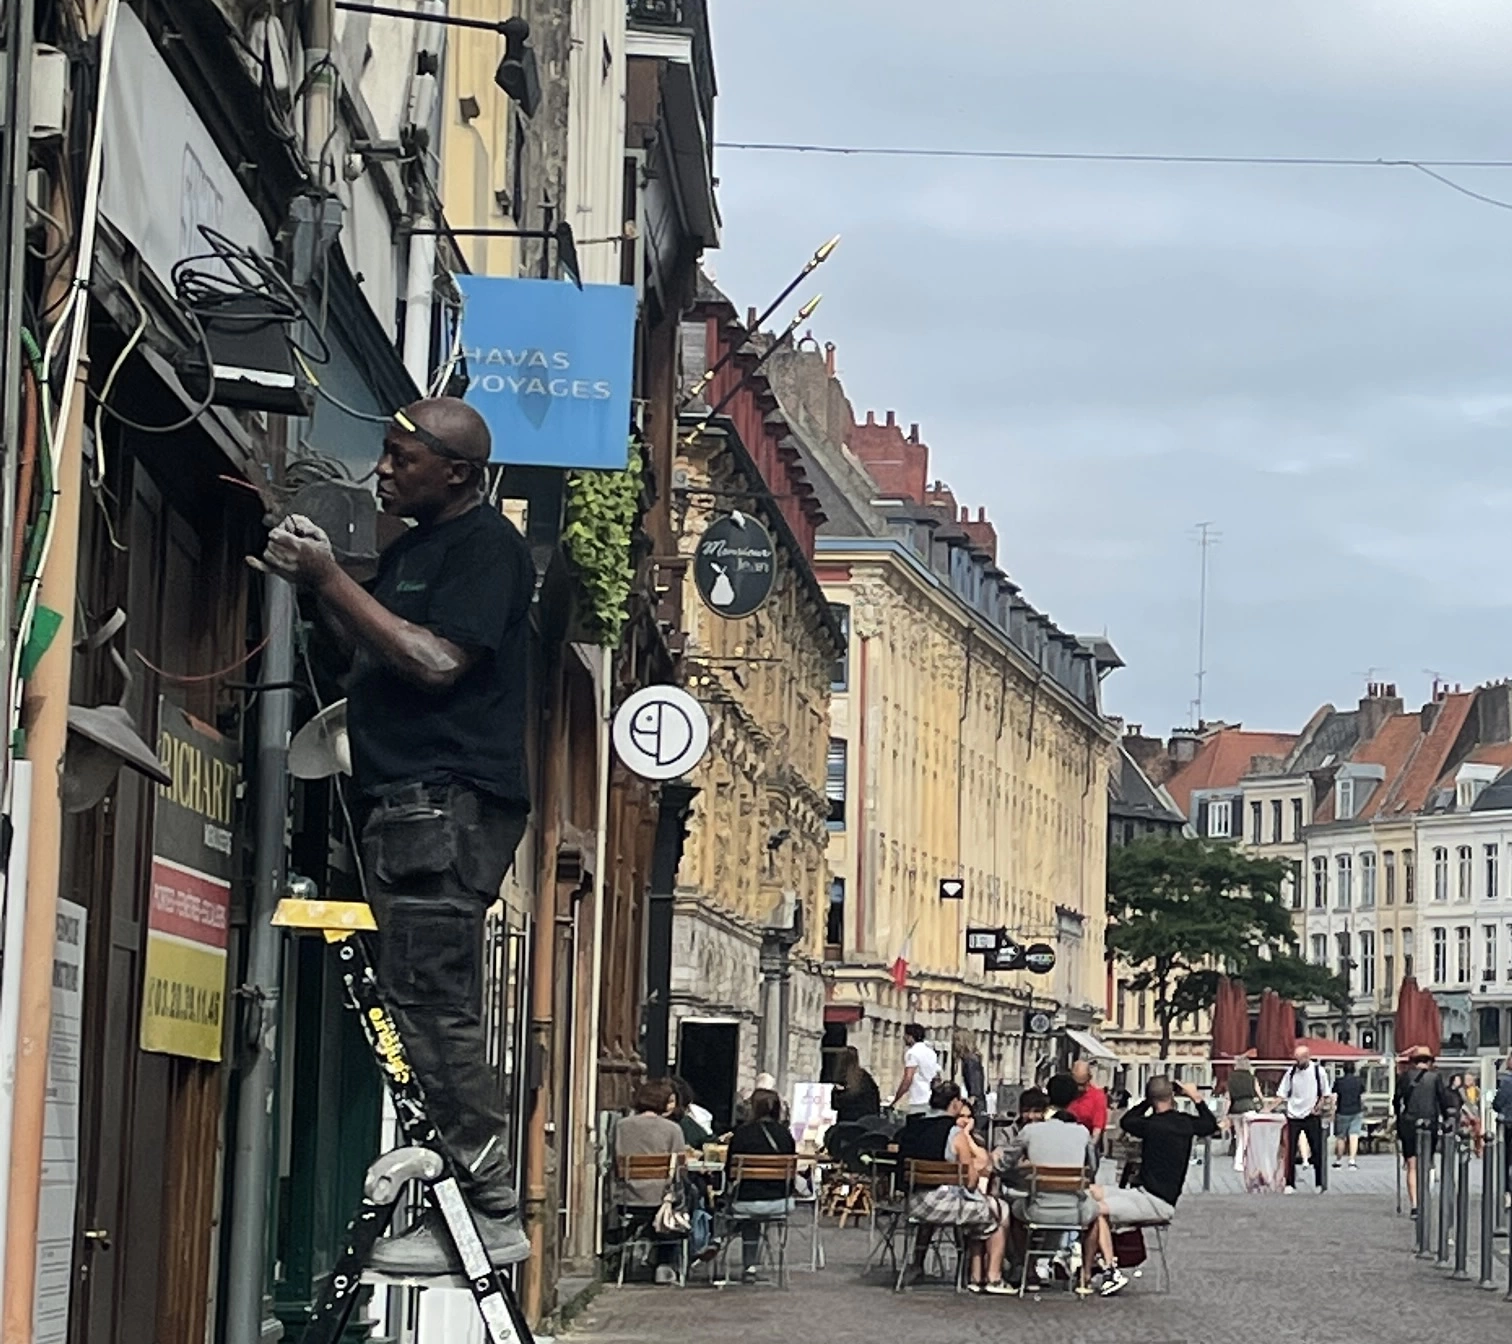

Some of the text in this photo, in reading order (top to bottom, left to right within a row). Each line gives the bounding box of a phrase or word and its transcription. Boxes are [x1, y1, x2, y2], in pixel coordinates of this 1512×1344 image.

[463, 346, 570, 370] HAVAS
[467, 374, 611, 400] VOYAGES
[158, 731, 235, 825] RICHART
